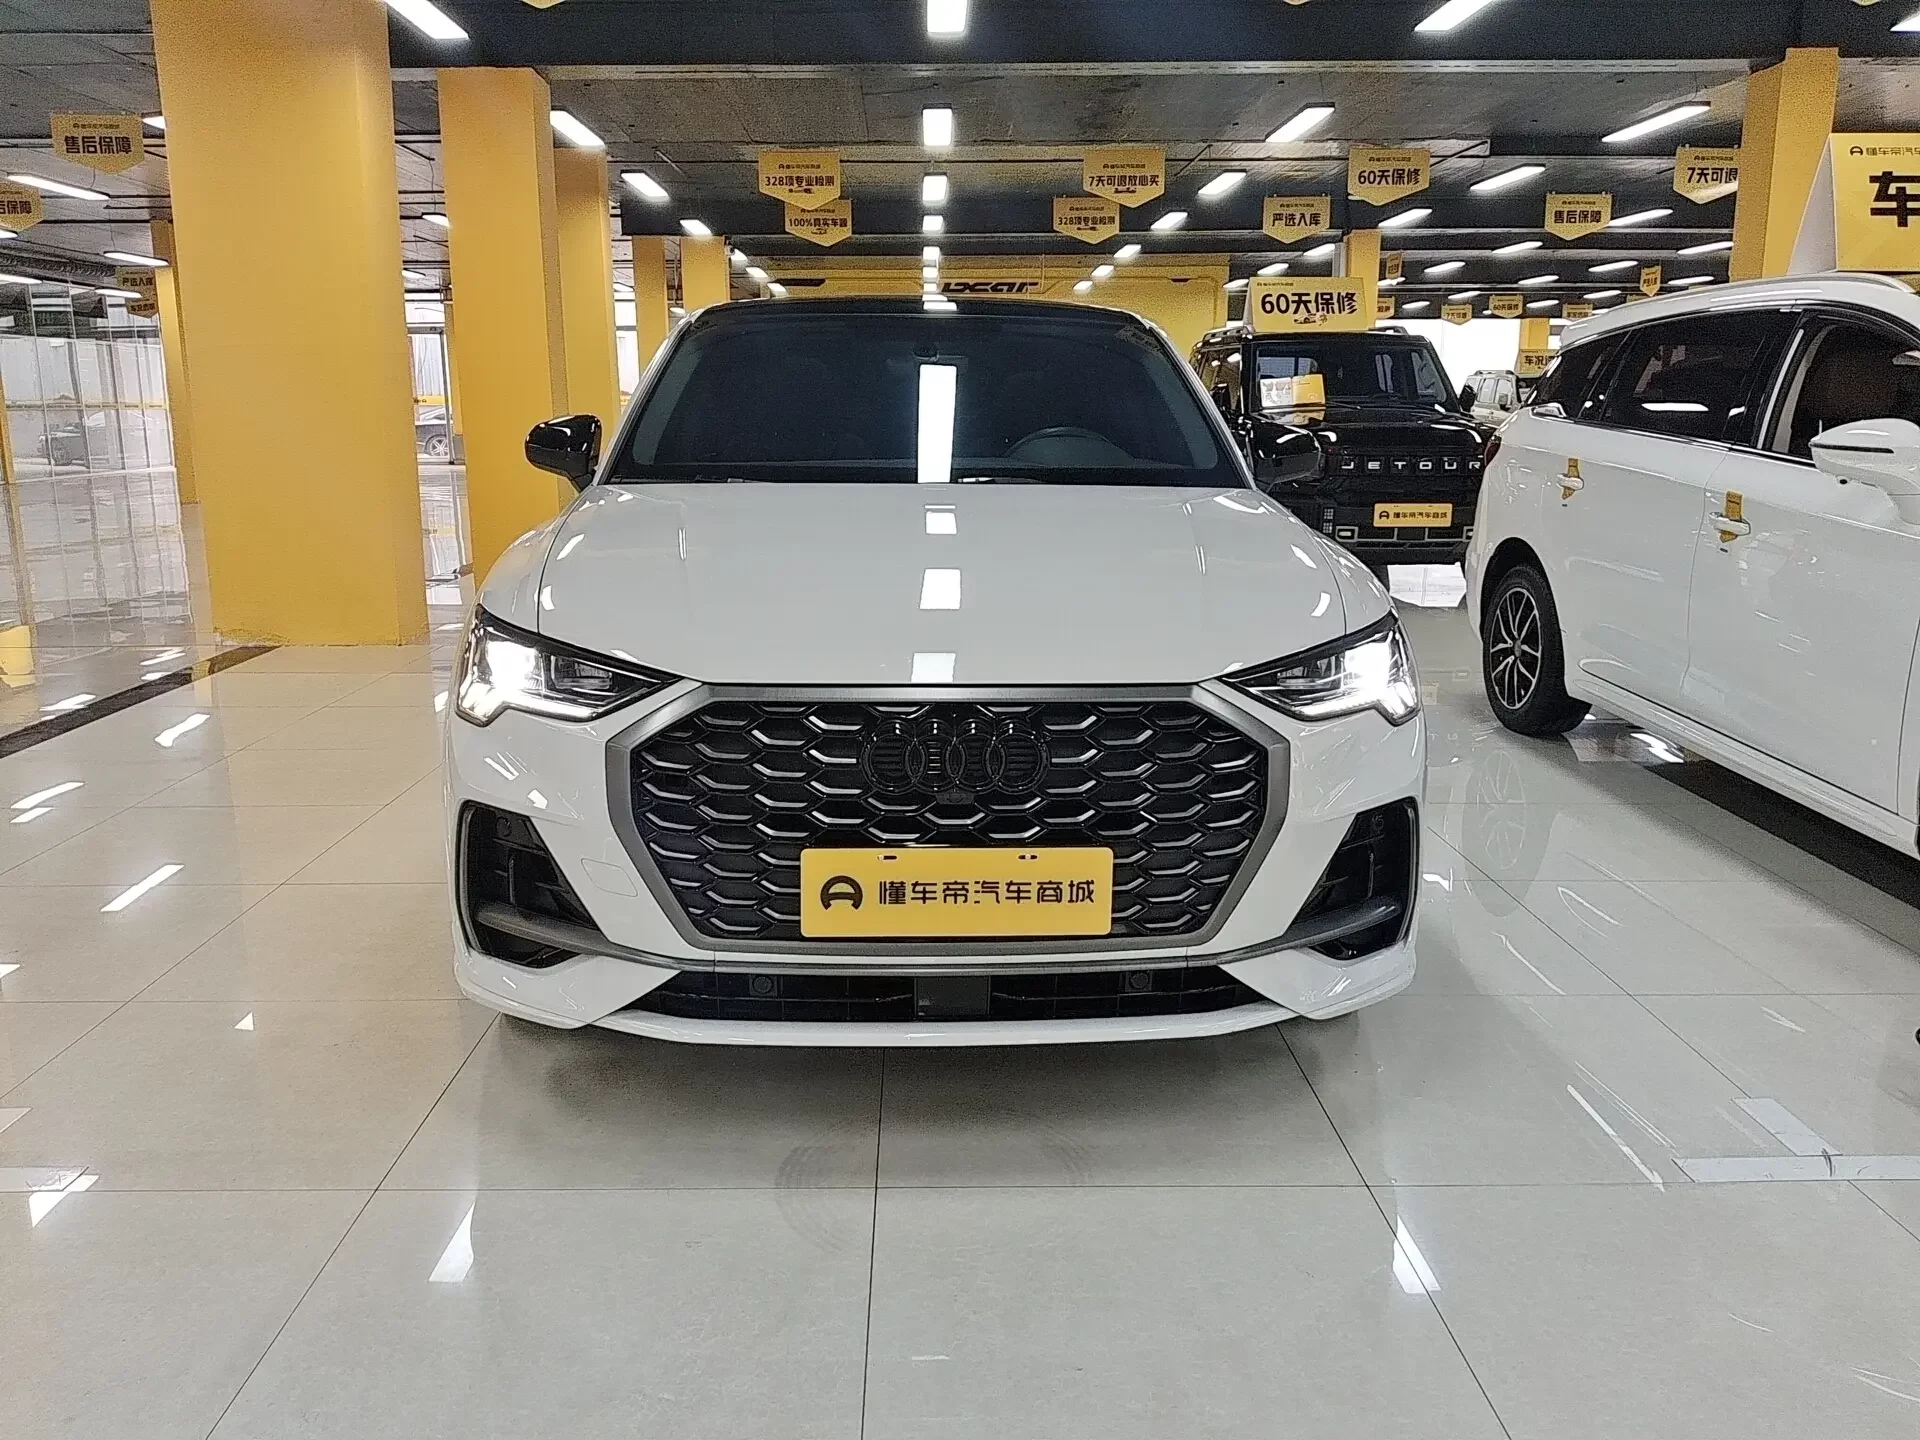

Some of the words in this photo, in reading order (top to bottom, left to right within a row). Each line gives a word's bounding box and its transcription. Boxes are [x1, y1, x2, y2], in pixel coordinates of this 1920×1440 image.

[64, 135, 132, 154] 售后保障
[765, 175, 835, 187] 328项专业检测
[1088, 174, 1160, 187] 7天可退放心买
[1358, 168, 1421, 185] 60天保修
[1687, 167, 1738, 184] 7天可退
[1868, 170, 1920, 228] 车
[1272, 212, 1321, 227] 严选入库
[1554, 210, 1602, 224] 售后保障
[1261, 291, 1358, 315] 60天保修
[1341, 461, 1481, 470] JETOUR
[878, 880, 1095, 905] 懂车帝汽车商城
